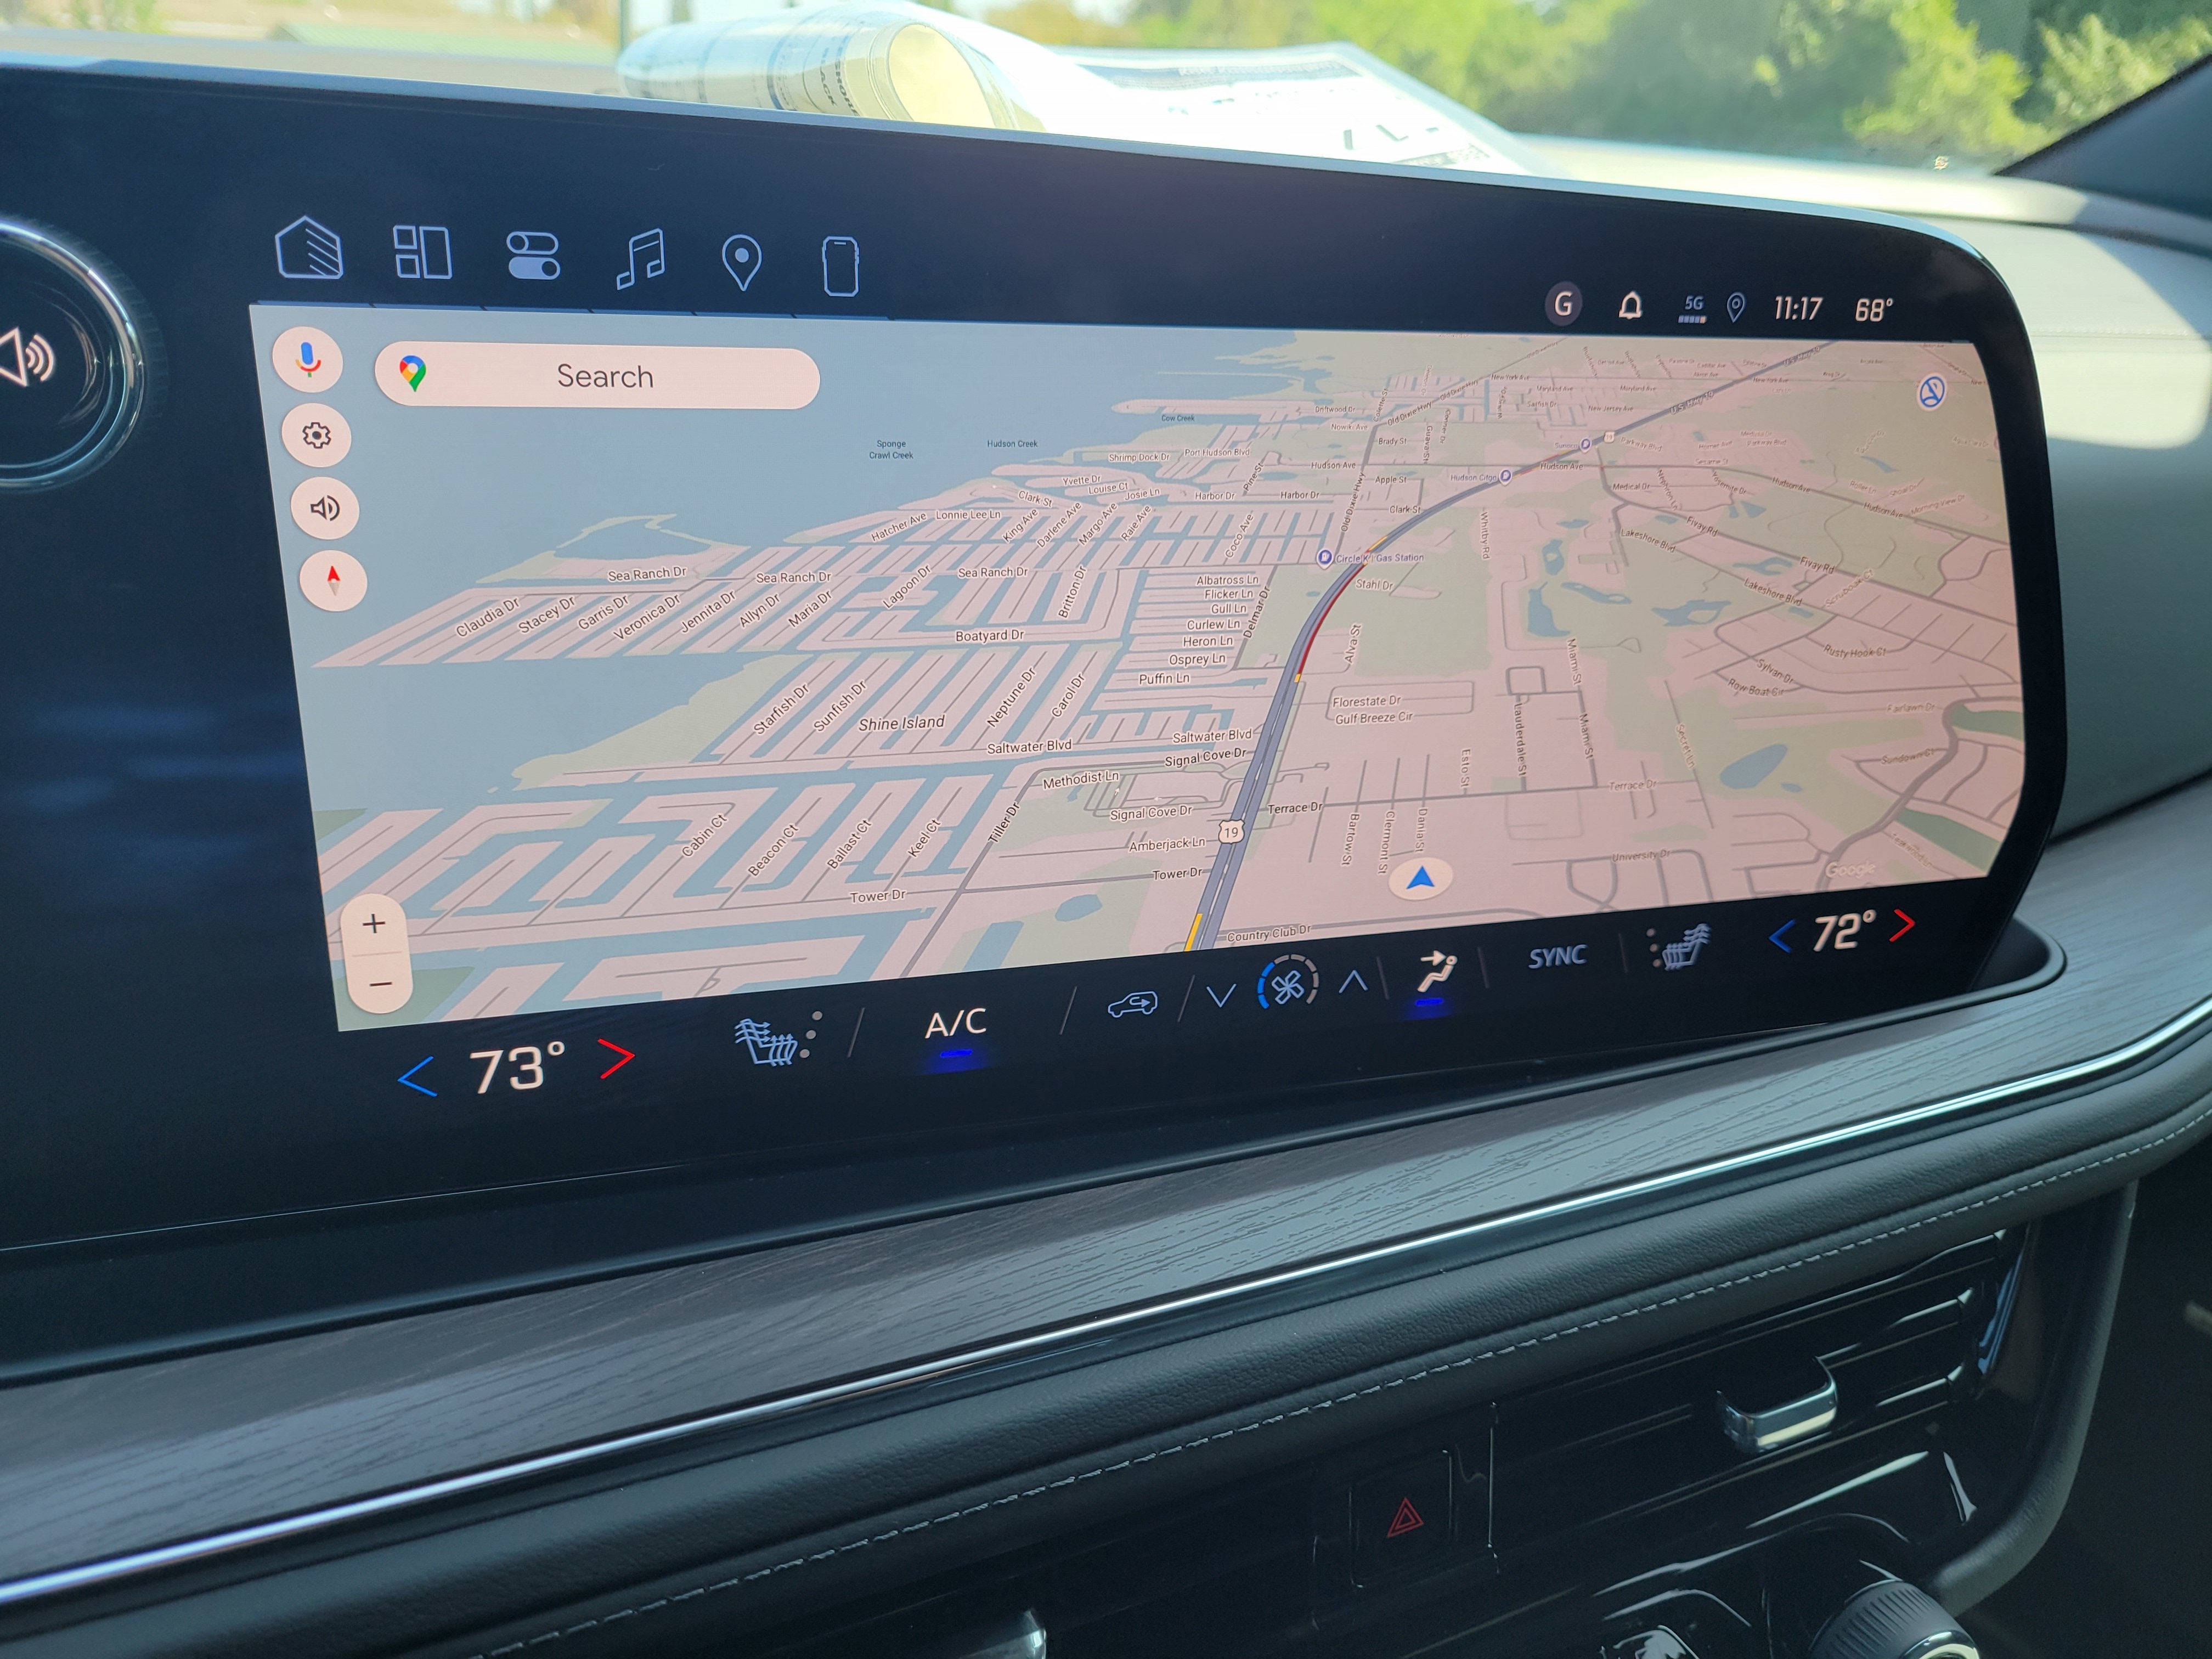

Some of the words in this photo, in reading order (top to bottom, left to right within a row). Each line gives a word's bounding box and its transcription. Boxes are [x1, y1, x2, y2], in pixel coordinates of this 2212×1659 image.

[1554, 291, 1572, 316] G
[1685, 296, 1704, 310] 5G
[1775, 296, 1822, 320] 11:17
[1855, 297, 1893, 321] 68°
[556, 362, 654, 390] Search
[877, 440, 906, 448] Sponge
[1109, 454, 1136, 462] Shrimp
[1139, 453, 1158, 461] Dock
[1063, 476, 1090, 486] Yvette
[1091, 475, 1101, 483] Dr
[1088, 484, 1116, 494] Louise
[1119, 482, 1128, 490] Ct
[1772, 477, 1796, 491] Hudson
[1794, 483, 1810, 493] Ave
[1018, 490, 1041, 505] Clark
[1042, 497, 1052, 507] St
[1125, 489, 1147, 501] Josie
[1149, 488, 1160, 496] Ln
[1341, 519, 1351, 532] Old
[1346, 494, 1358, 517] Dixie
[1353, 472, 1365, 492] Hwy
[936, 511, 968, 520] Lonnie
[970, 511, 987, 519] Lee
[871, 522, 908, 542] Hatcher
[909, 514, 927, 526] Ave
[1003, 523, 1024, 543] King
[1021, 509, 1039, 525] Ave
[1037, 517, 1068, 549] Darlene
[1066, 502, 1082, 519] Ave
[1481, 512, 1489, 546] Whitby
[1621, 529, 1658, 547] Lakeshore
[1658, 540, 1676, 552] Blvd
[1336, 555, 1362, 563] Circle
[1482, 548, 1489, 559] Rd
[608, 571, 630, 582] Sea
[633, 568, 670, 580] Ranch
[674, 567, 686, 577] Dr
[757, 573, 777, 583] Sea
[781, 573, 815, 582] Ranch
[819, 573, 831, 582] Dr
[1197, 575, 1244, 586] Albatross
[1247, 575, 1259, 584] Ln
[883, 577, 918, 609] Lagoon
[917, 565, 931, 578] Dr
[1205, 590, 1237, 600] Flicker
[1240, 589, 1253, 599] Ln
[456, 607, 505, 638] Claudia
[503, 597, 521, 612] Dr
[518, 605, 560, 634] Stacey
[560, 596, 575, 610] Dr
[613, 605, 666, 641] Veronica
[665, 594, 681, 607] Dr
[681, 600, 722, 633] Jennita
[720, 590, 736, 604] Dr
[1187, 620, 1224, 630] Curlew
[1228, 619, 1240, 629] Ln
[956, 630, 1007, 644] Boatyard
[1011, 630, 1024, 640] Dr
[1170, 653, 1209, 667] Osprey
[1212, 653, 1225, 663] Ln
[1139, 673, 1172, 685] Puffin
[1176, 673, 1189, 683] Ln
[1757, 659, 1782, 679] Sylvan
[1781, 674, 1794, 685] Dr
[987, 678, 1026, 727] Neptune
[1023, 667, 1036, 681] Dr
[1333, 697, 1386, 708] Florestate
[1389, 696, 1401, 705] Dr
[754, 693, 796, 736] Starfish
[793, 683, 810, 699] Dr
[1336, 714, 1357, 724] Gulf
[1361, 713, 1395, 723] Breeze
[1398, 712, 1413, 721] Cir
[859, 718, 898, 732] Shine
[902, 715, 945, 730] Island
[1514, 703, 1526, 763] Lauderdale
[988, 741, 1043, 754] Saltwater
[1047, 740, 1071, 751] Blvd
[1165, 754, 1200, 768] Signal
[1203, 750, 1231, 761] Cove
[1233, 748, 1246, 758] Dr
[1518, 764, 1526, 776] St
[1043, 772, 1102, 789] Methodist
[1105, 771, 1119, 782] Ln
[1268, 804, 1309, 815] Terrace
[1311, 802, 1323, 811] Dr
[988, 815, 1012, 844] Tiller
[1006, 802, 1020, 817] Dr
[681, 825, 715, 859] Cabin
[712, 814, 727, 830] Ct
[1224, 828, 1238, 838] 19
[1380, 811, 1395, 861] Clermont
[748, 837, 787, 878] Beacon
[784, 824, 799, 841] Ct
[1129, 839, 1189, 853] Amberjack
[1193, 837, 1205, 847] Ln
[1378, 862, 1388, 874] St
[1825, 861, 1876, 877] Google
[850, 890, 888, 904] Tower
[891, 889, 906, 900] Dr
[1227, 930, 1269, 943] Country
[1272, 927, 1296, 938] Club
[1299, 924, 1311, 934] Dr
[1814, 910, 1876, 952] 72°
[1528, 944, 1588, 969] SYNC
[924, 1008, 986, 1039] A/C
[470, 1041, 566, 1094] 73°
